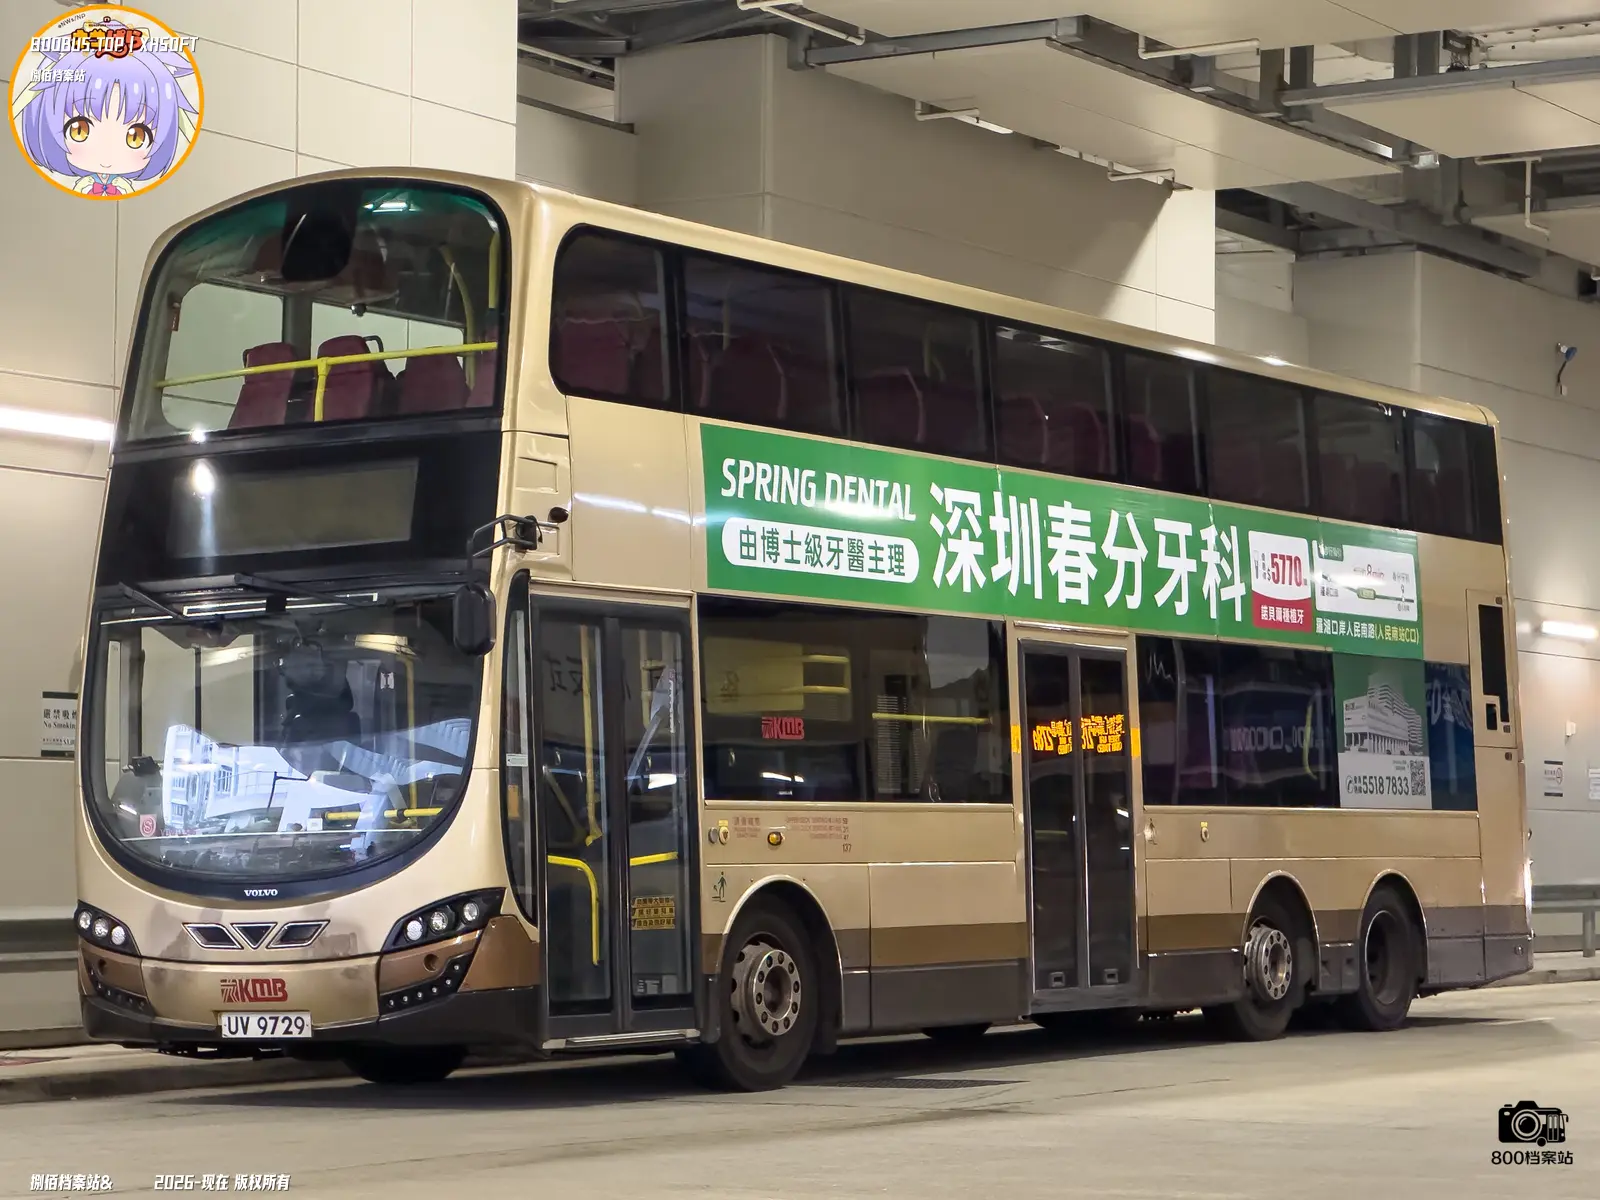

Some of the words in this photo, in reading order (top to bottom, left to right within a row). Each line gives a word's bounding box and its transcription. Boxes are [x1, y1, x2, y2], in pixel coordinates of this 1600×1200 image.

[721, 458, 816, 508] SPRING
[824, 472, 917, 522] DENTAL
[739, 525, 906, 577] 由博士級牙醫主理
[929, 482, 1246, 621] 深圳春分牙科
[1362, 776, 1385, 795] 5518
[1386, 776, 1410, 795] 7833
[244, 889, 278, 897] VOLVO
[238, 978, 288, 1003] KMB
[227, 1016, 251, 1036] UV
[257, 1015, 305, 1036] 9729
